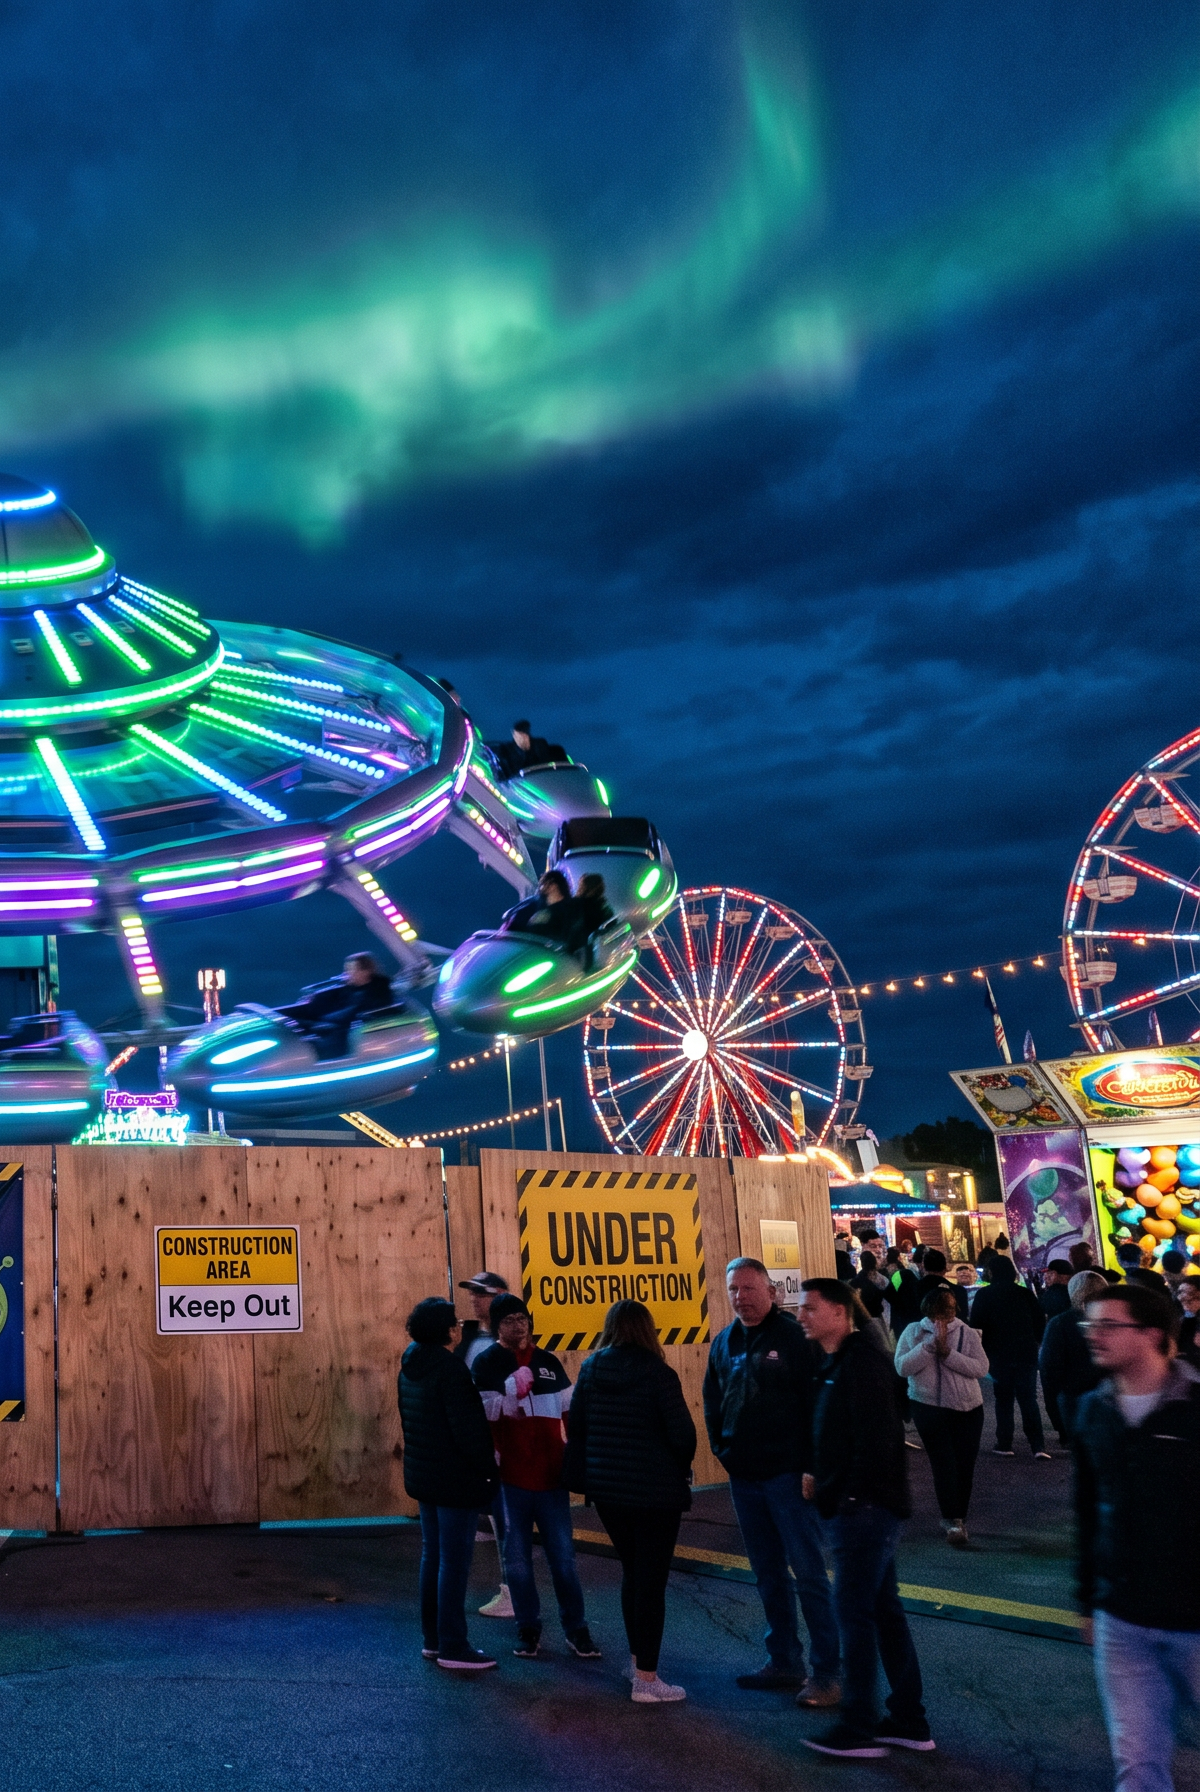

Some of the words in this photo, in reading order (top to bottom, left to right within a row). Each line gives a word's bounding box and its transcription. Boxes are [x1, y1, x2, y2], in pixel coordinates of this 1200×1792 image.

[162, 1236, 293, 1257] CONSTRUCTION
[547, 1211, 679, 1268] UNDER
[206, 1260, 252, 1280] AREA
[539, 1273, 693, 1306] CONSTRUCTION
[169, 1295, 236, 1324] Keep
[244, 1294, 291, 1317] Out
